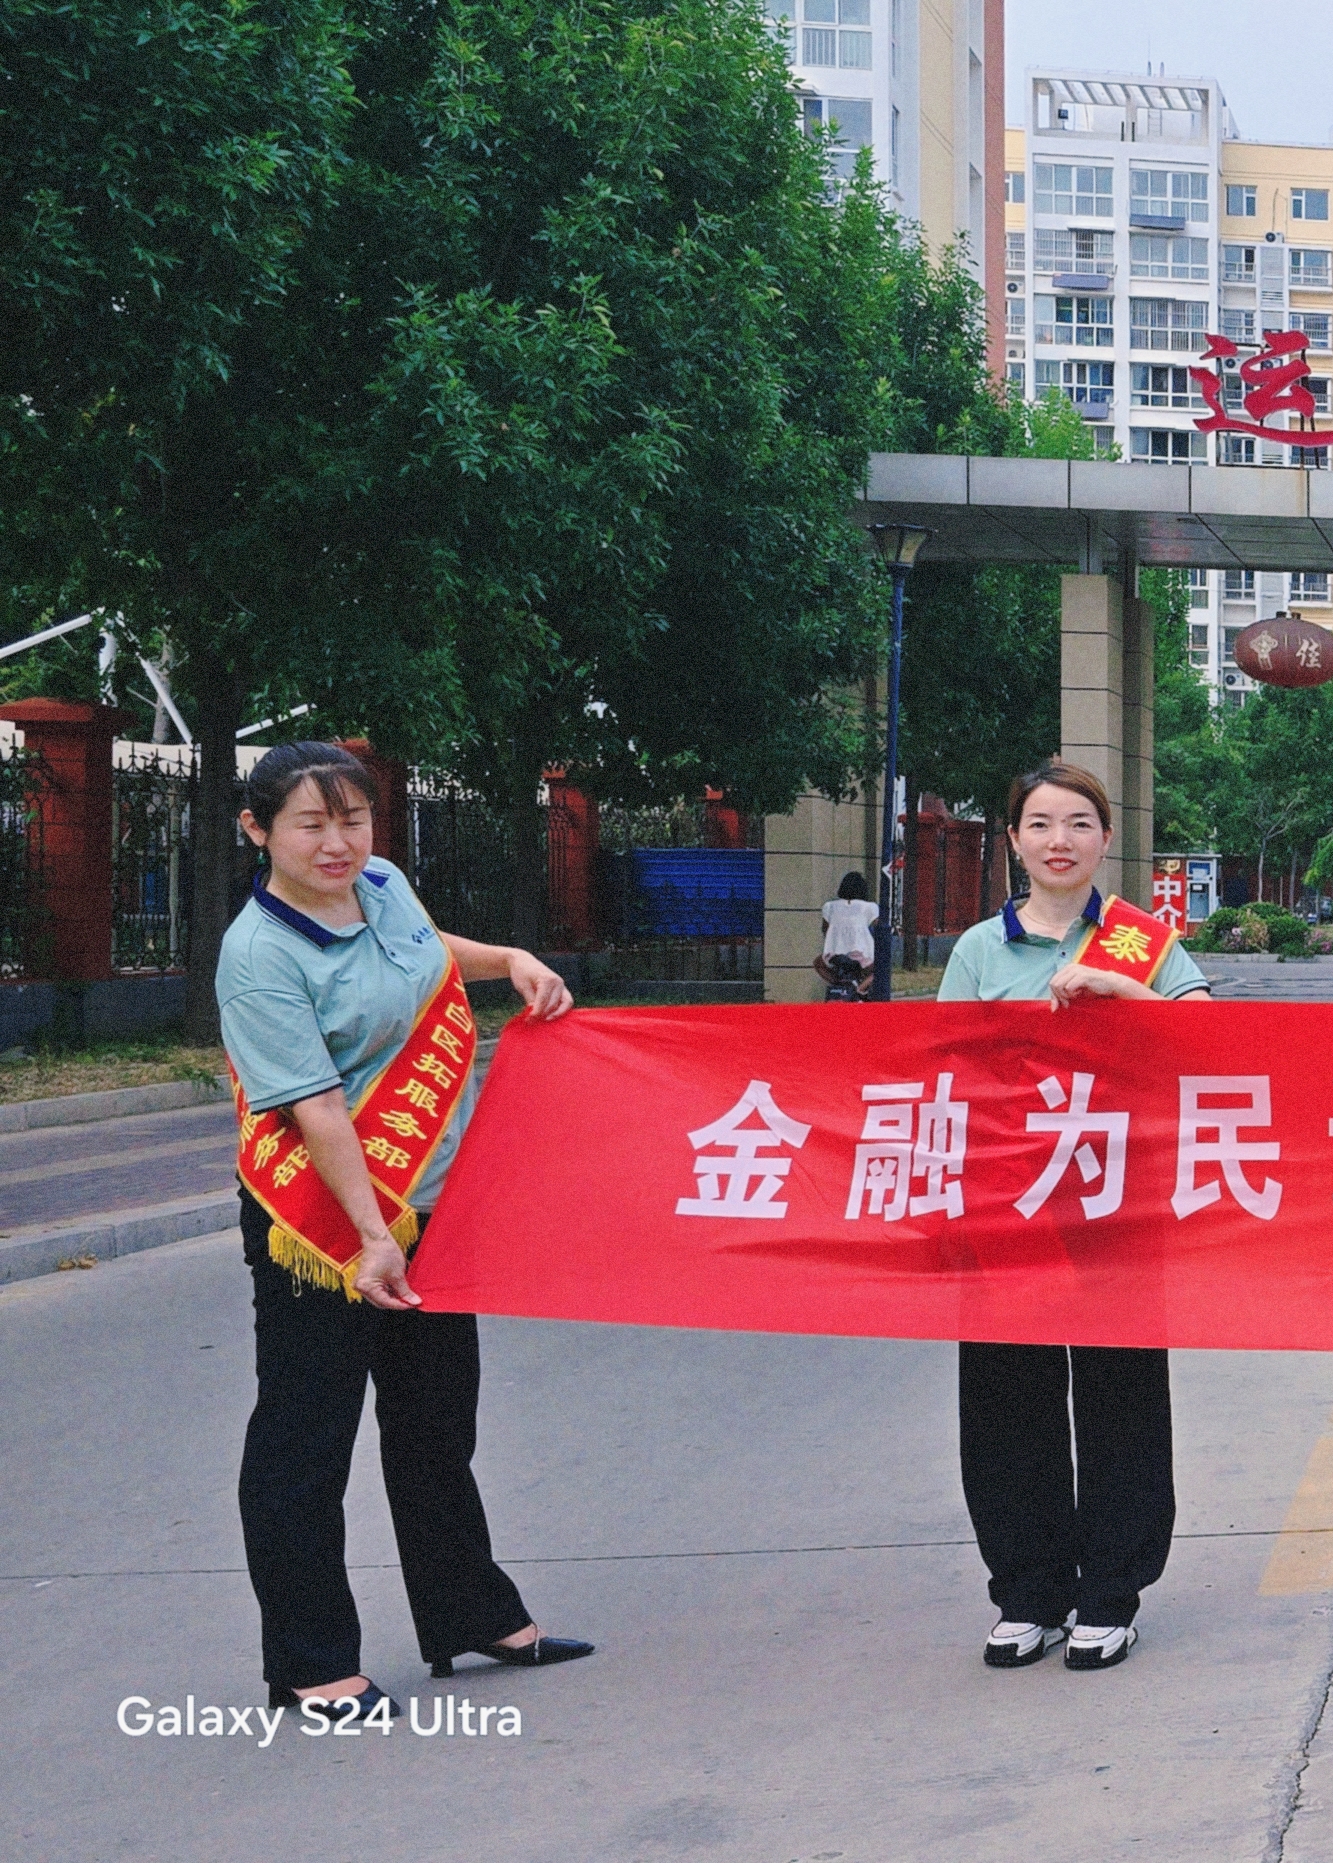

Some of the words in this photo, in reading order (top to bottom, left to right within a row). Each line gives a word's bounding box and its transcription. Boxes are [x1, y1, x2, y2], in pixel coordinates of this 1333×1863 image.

[1153, 876, 1182, 928] 中介
[1100, 924, 1152, 963] 泰
[362, 983, 474, 1170] 白区拓服务部
